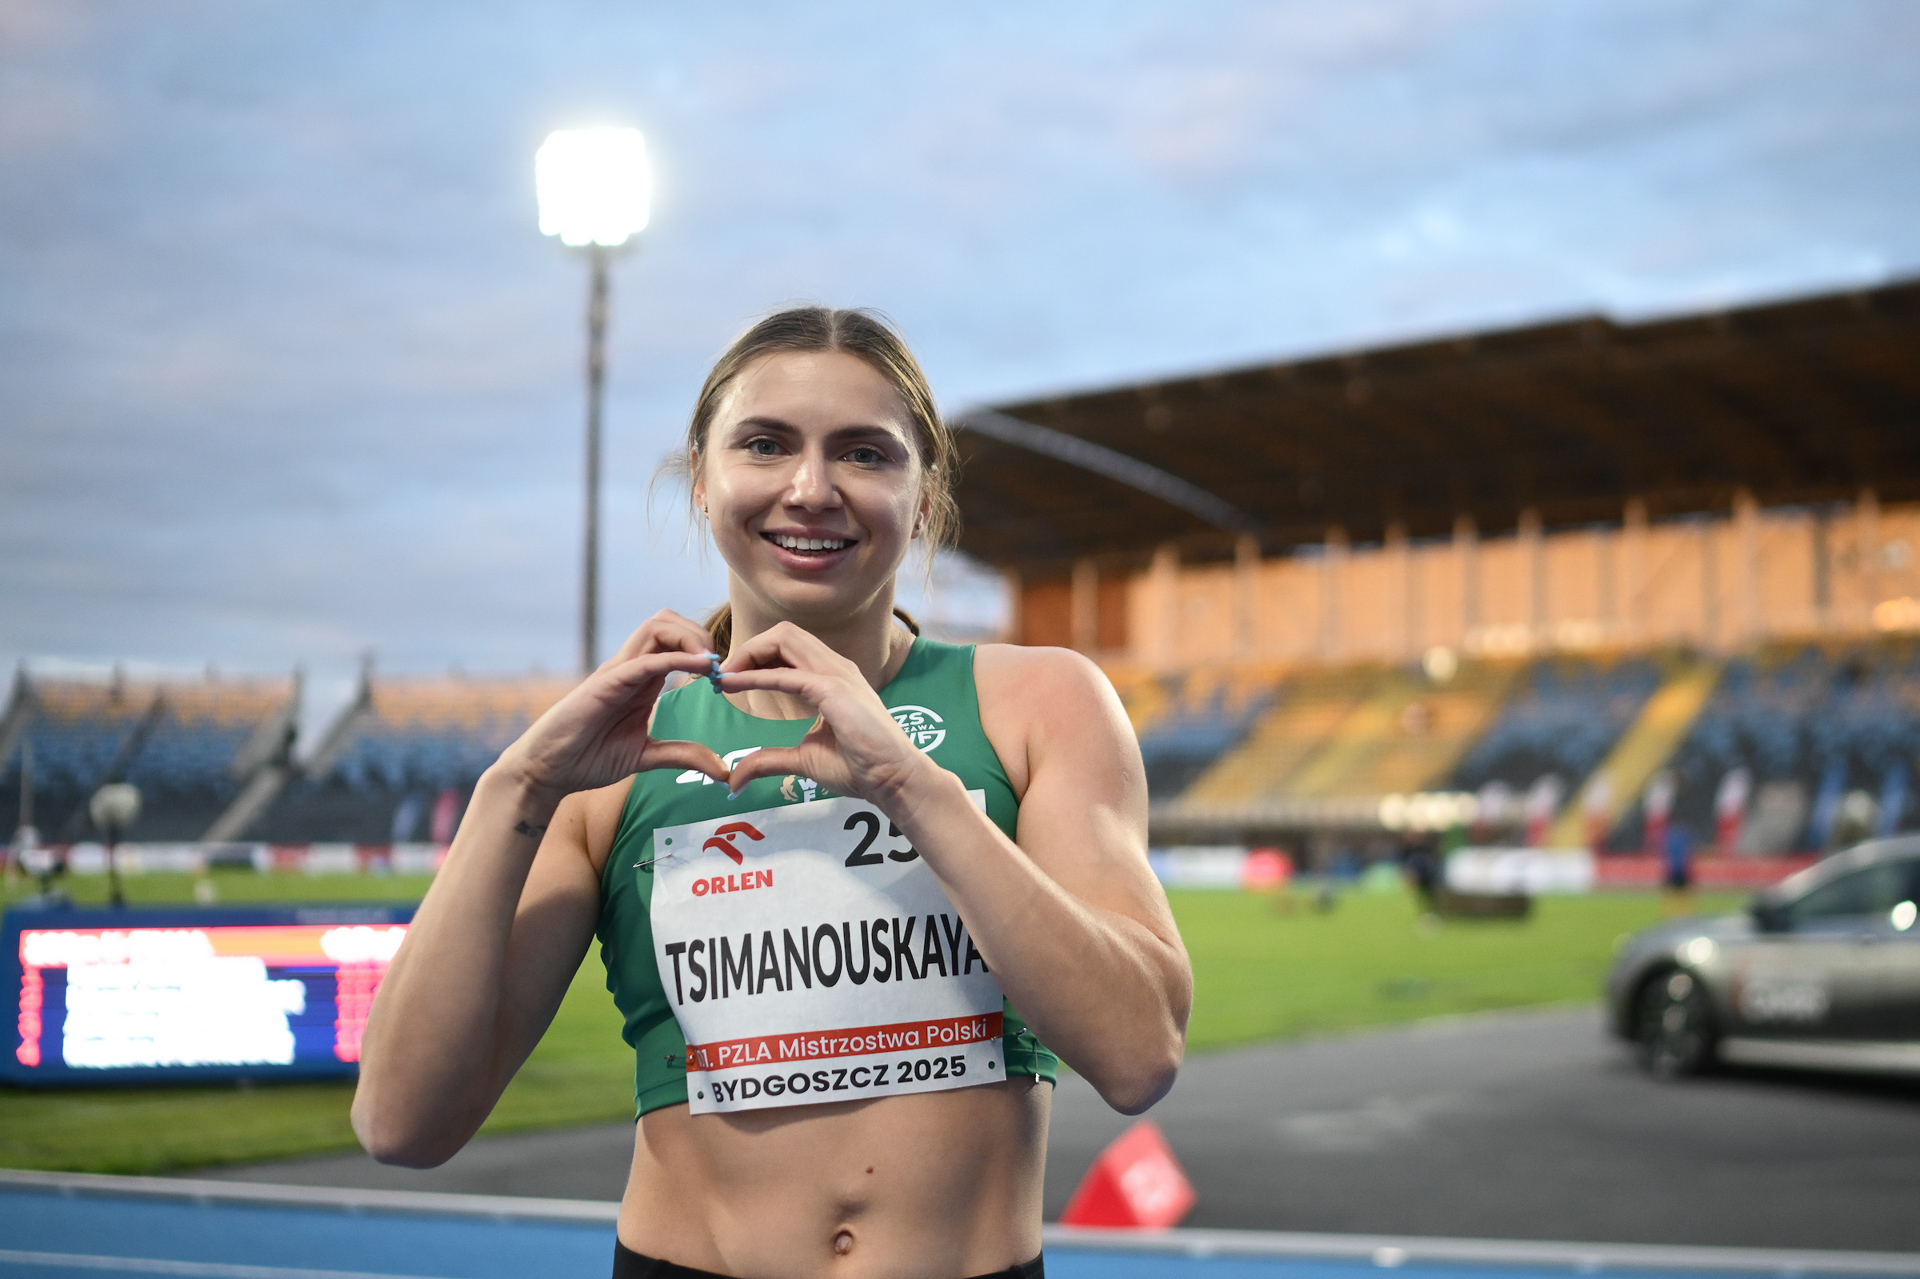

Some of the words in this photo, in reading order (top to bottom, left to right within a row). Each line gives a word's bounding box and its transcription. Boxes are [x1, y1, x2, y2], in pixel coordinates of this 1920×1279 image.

[893, 711, 925, 728] ZS
[691, 869, 774, 897] ORLEN
[665, 913, 990, 1006] TSIMANOUSKAYA
[718, 1041, 772, 1066] PZLA
[779, 1029, 920, 1059] Mistrzostwa
[926, 1017, 987, 1044] Polski
[711, 1064, 889, 1103] BYDGOSZCZ
[897, 1055, 967, 1084] 2025
